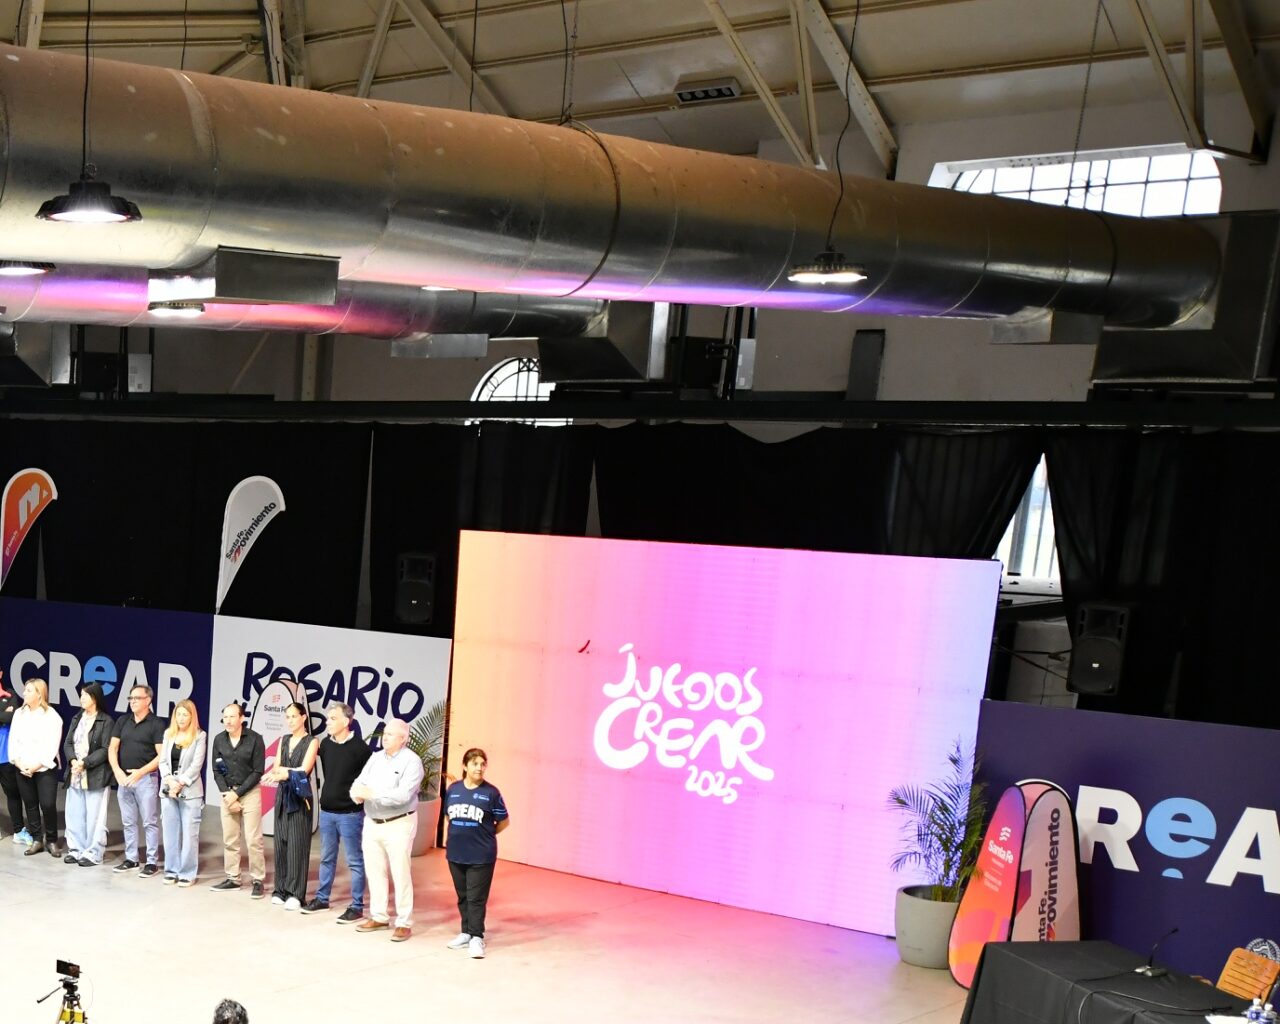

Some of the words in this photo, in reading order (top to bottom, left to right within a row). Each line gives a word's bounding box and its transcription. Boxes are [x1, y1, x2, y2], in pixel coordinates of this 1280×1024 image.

[592, 696, 775, 781] CREAR
[684, 764, 744, 805] 2025
[988, 839, 1008, 862] Santa
[1005, 850, 1014, 864] Fe
[1038, 898, 1048, 915] Fe
[1038, 917, 1047, 941] nta
